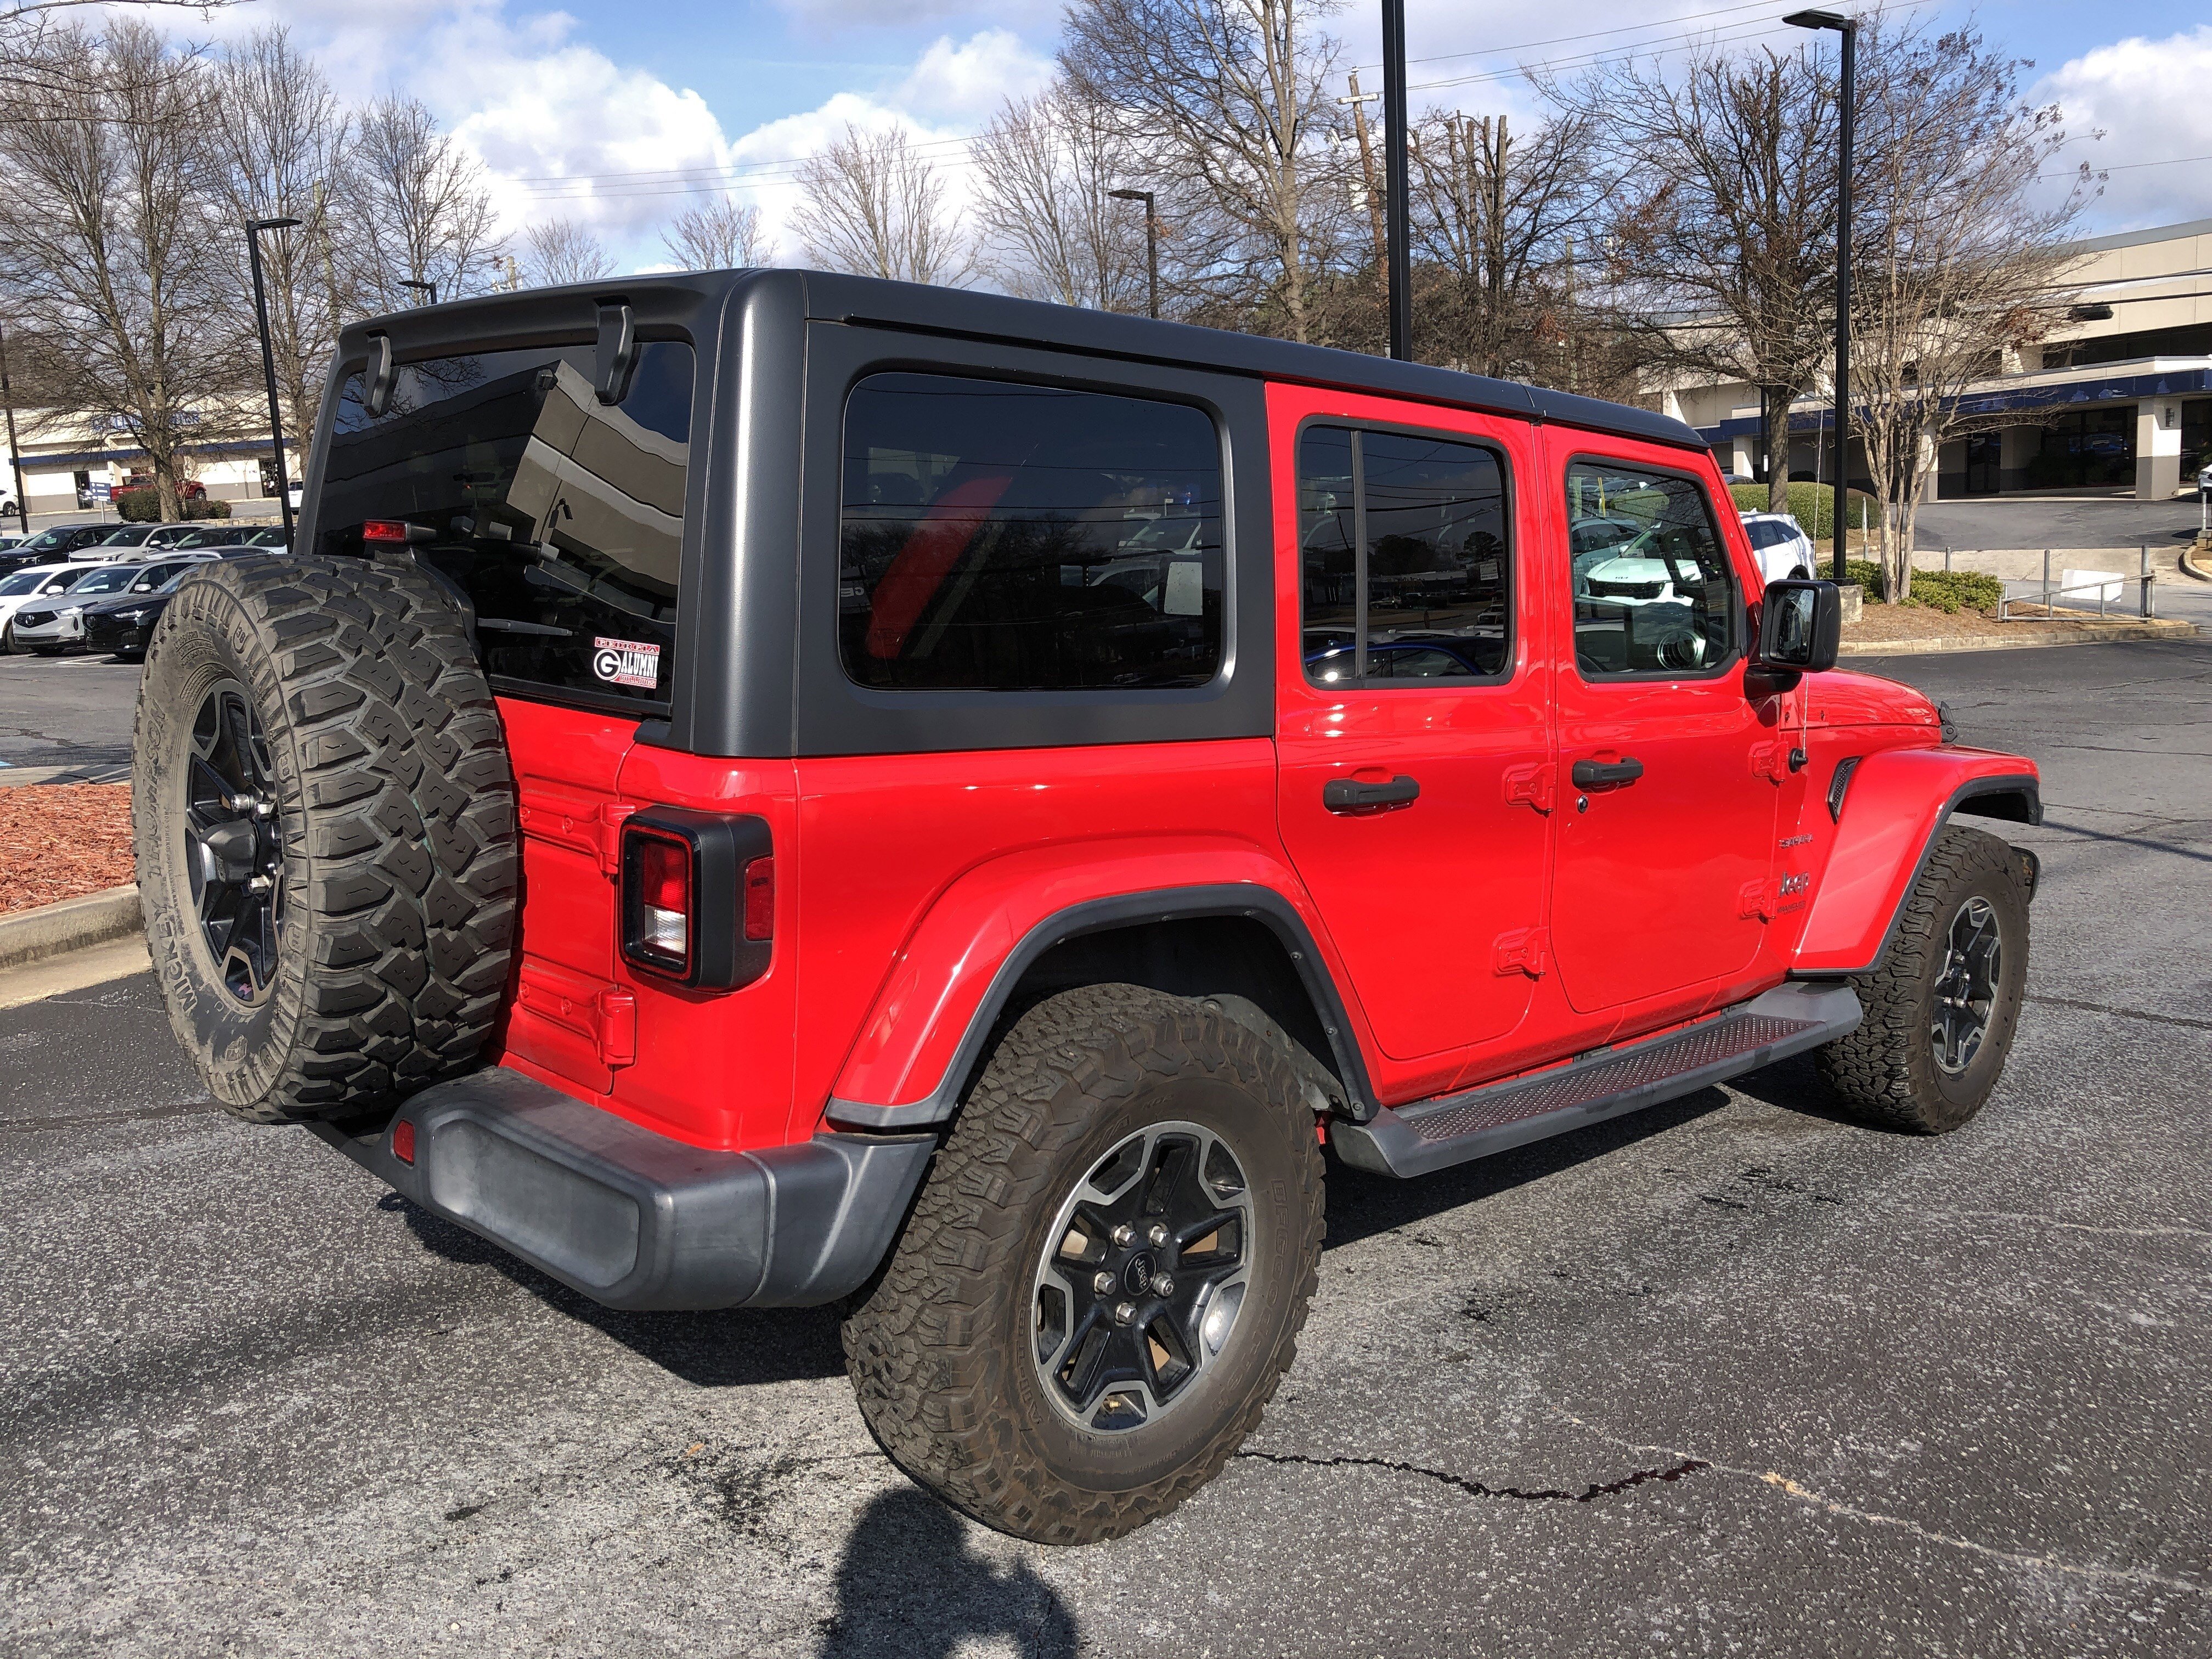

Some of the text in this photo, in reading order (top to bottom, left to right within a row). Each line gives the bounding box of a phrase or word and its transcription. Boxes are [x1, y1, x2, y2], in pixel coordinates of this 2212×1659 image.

[597, 639, 658, 653] GEORGIA
[596, 651, 658, 679] G ALUMNI
[619, 675, 656, 686] BULLDOGS
[143, 697, 196, 1013] MICKEY THOMPSON
[1135, 1257, 1148, 1290] Jeep
